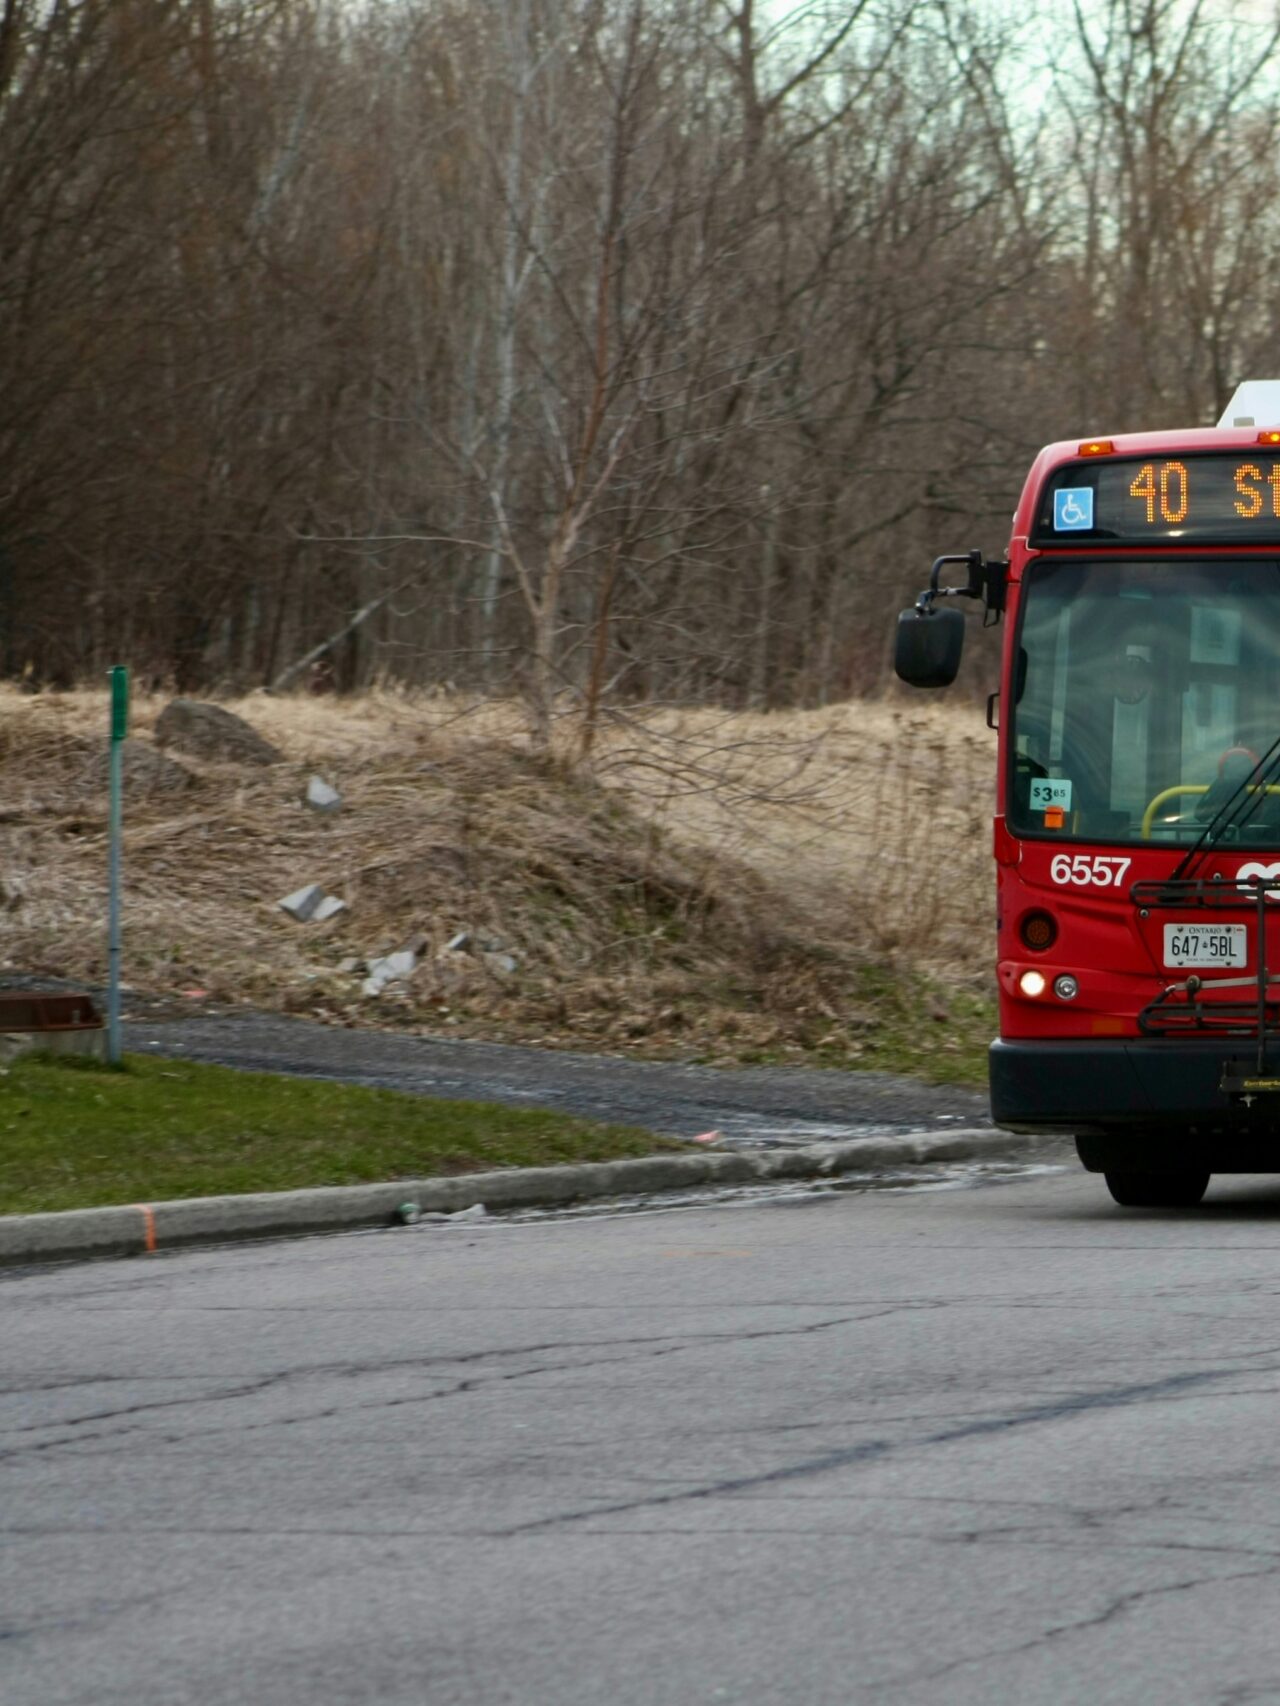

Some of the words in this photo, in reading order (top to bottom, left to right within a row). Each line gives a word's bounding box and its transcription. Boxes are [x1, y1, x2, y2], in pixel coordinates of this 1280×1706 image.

[1129, 462, 1188, 523] 40
[1050, 854, 1132, 887] 6557
[1171, 935, 1200, 957] 647
[1209, 935, 1238, 957] 5BL
